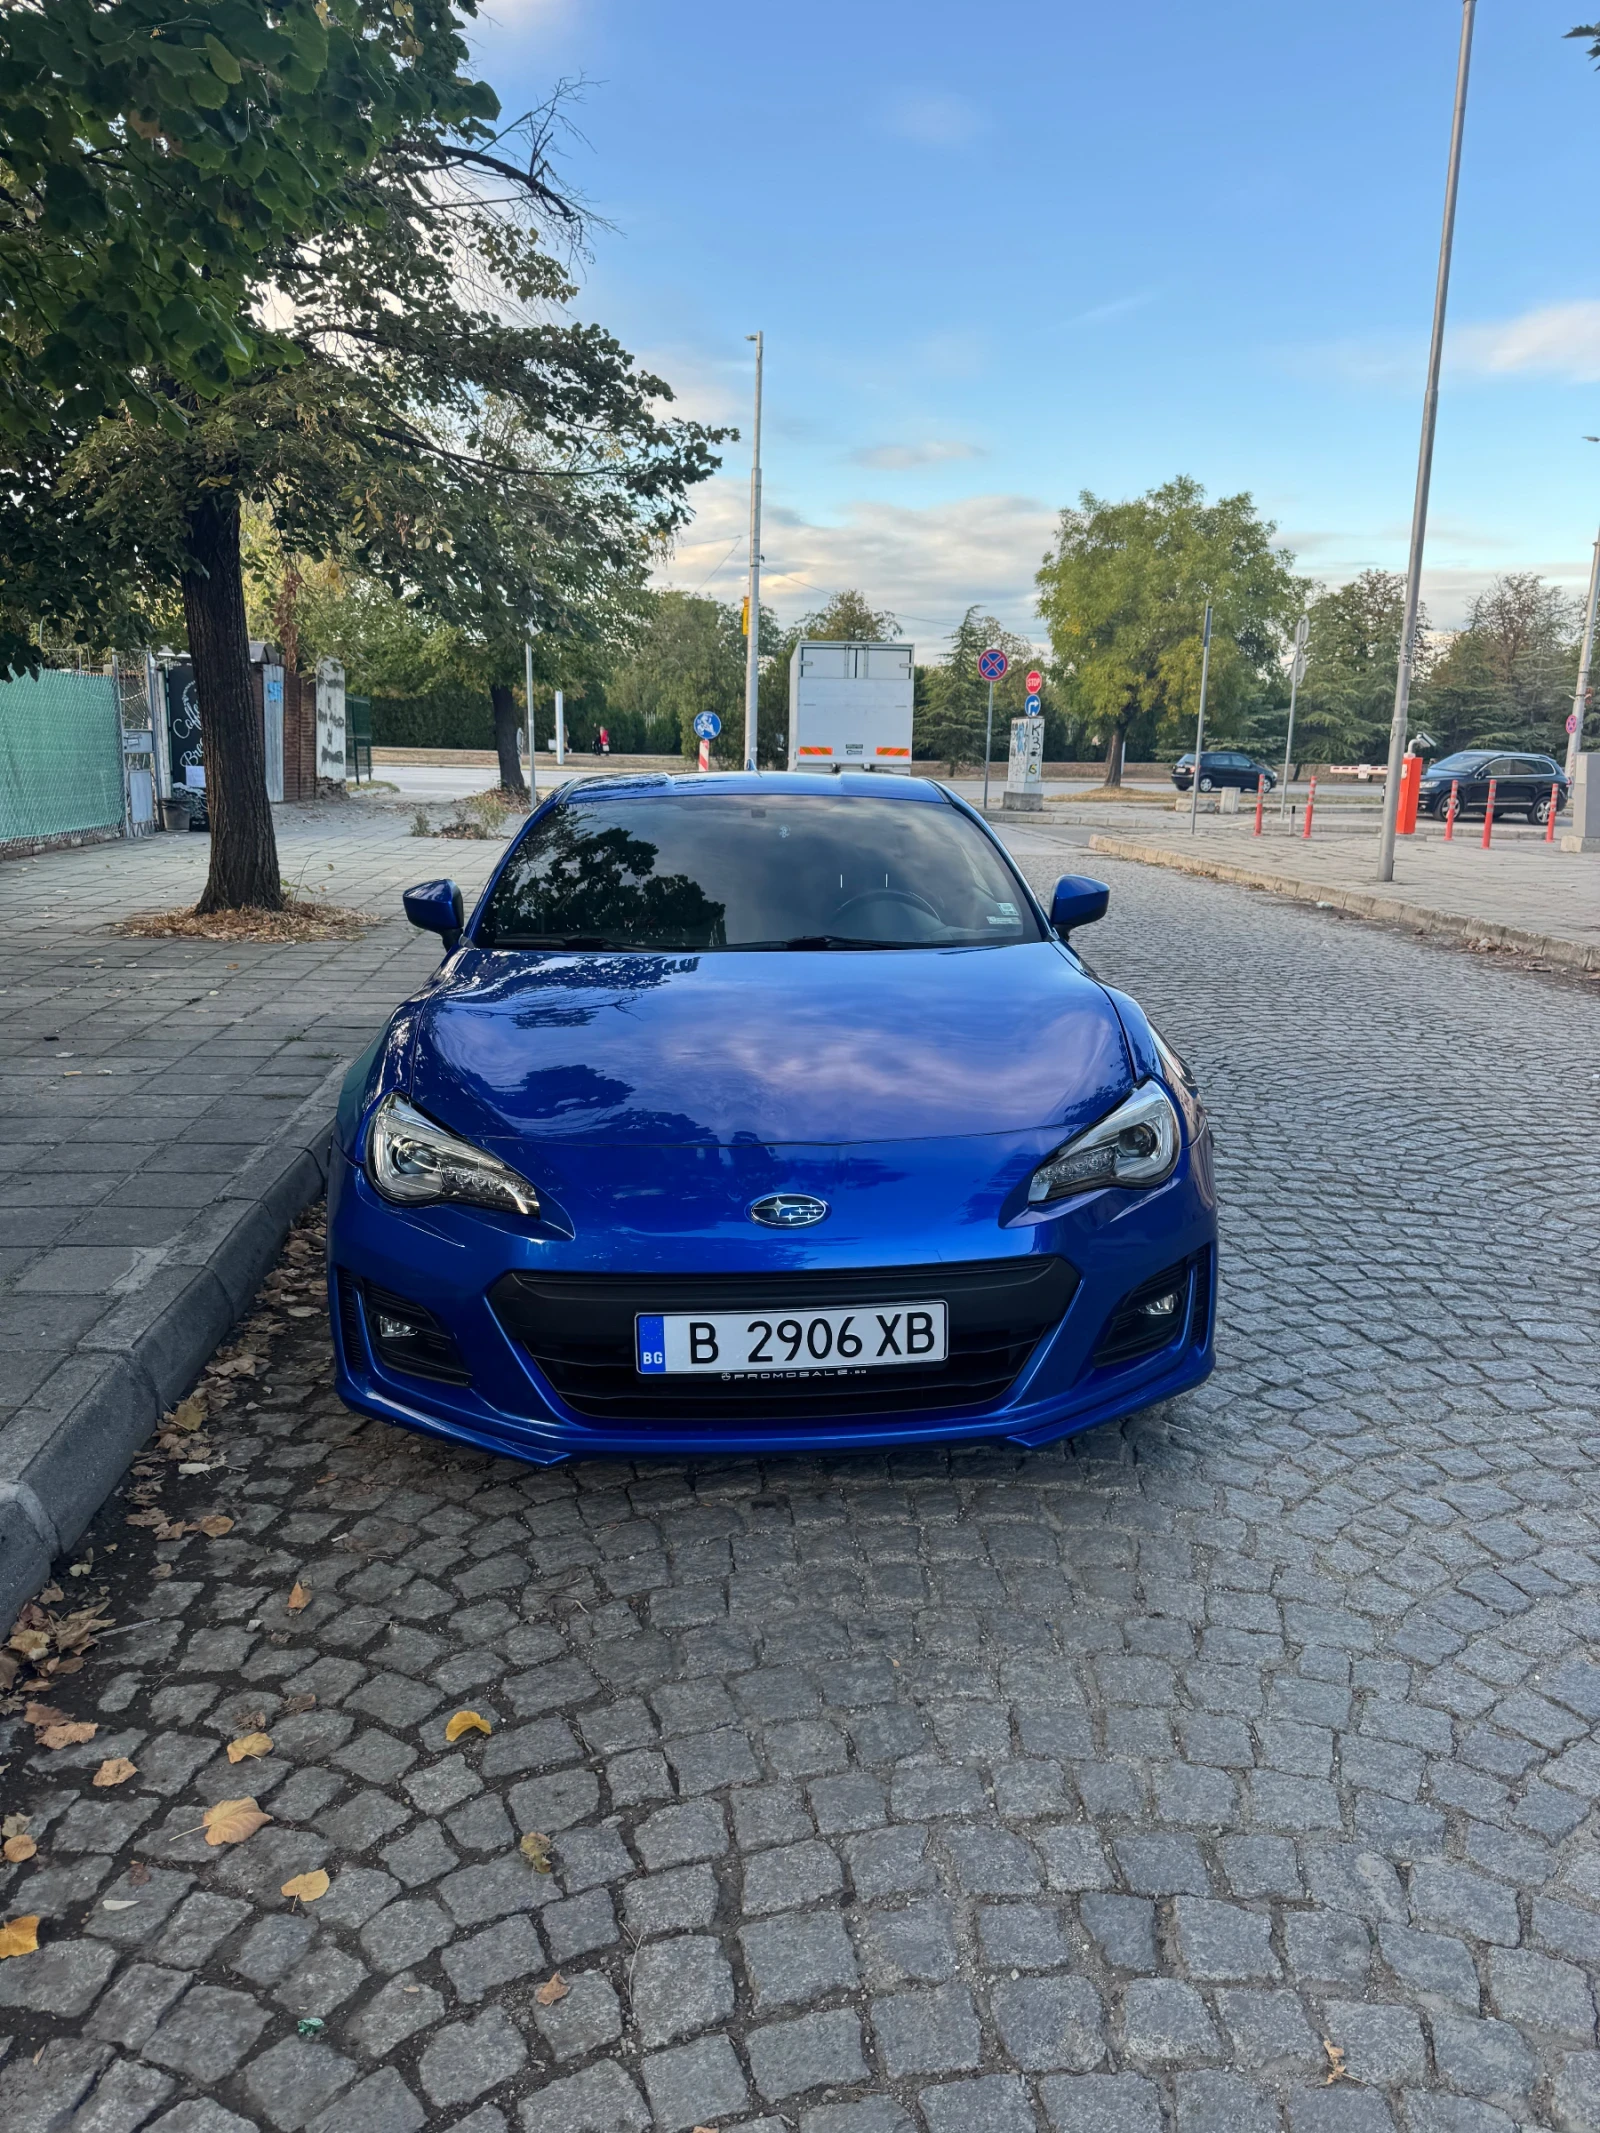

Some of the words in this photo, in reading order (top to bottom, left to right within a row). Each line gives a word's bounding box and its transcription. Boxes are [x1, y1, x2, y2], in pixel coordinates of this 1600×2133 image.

[1028, 678, 1040, 686] STOP
[173, 700, 202, 738] Coffe
[689, 1322, 719, 1364] B
[747, 1316, 863, 1363] 2906
[875, 1312, 935, 1357] XB
[643, 1352, 663, 1364] BG
